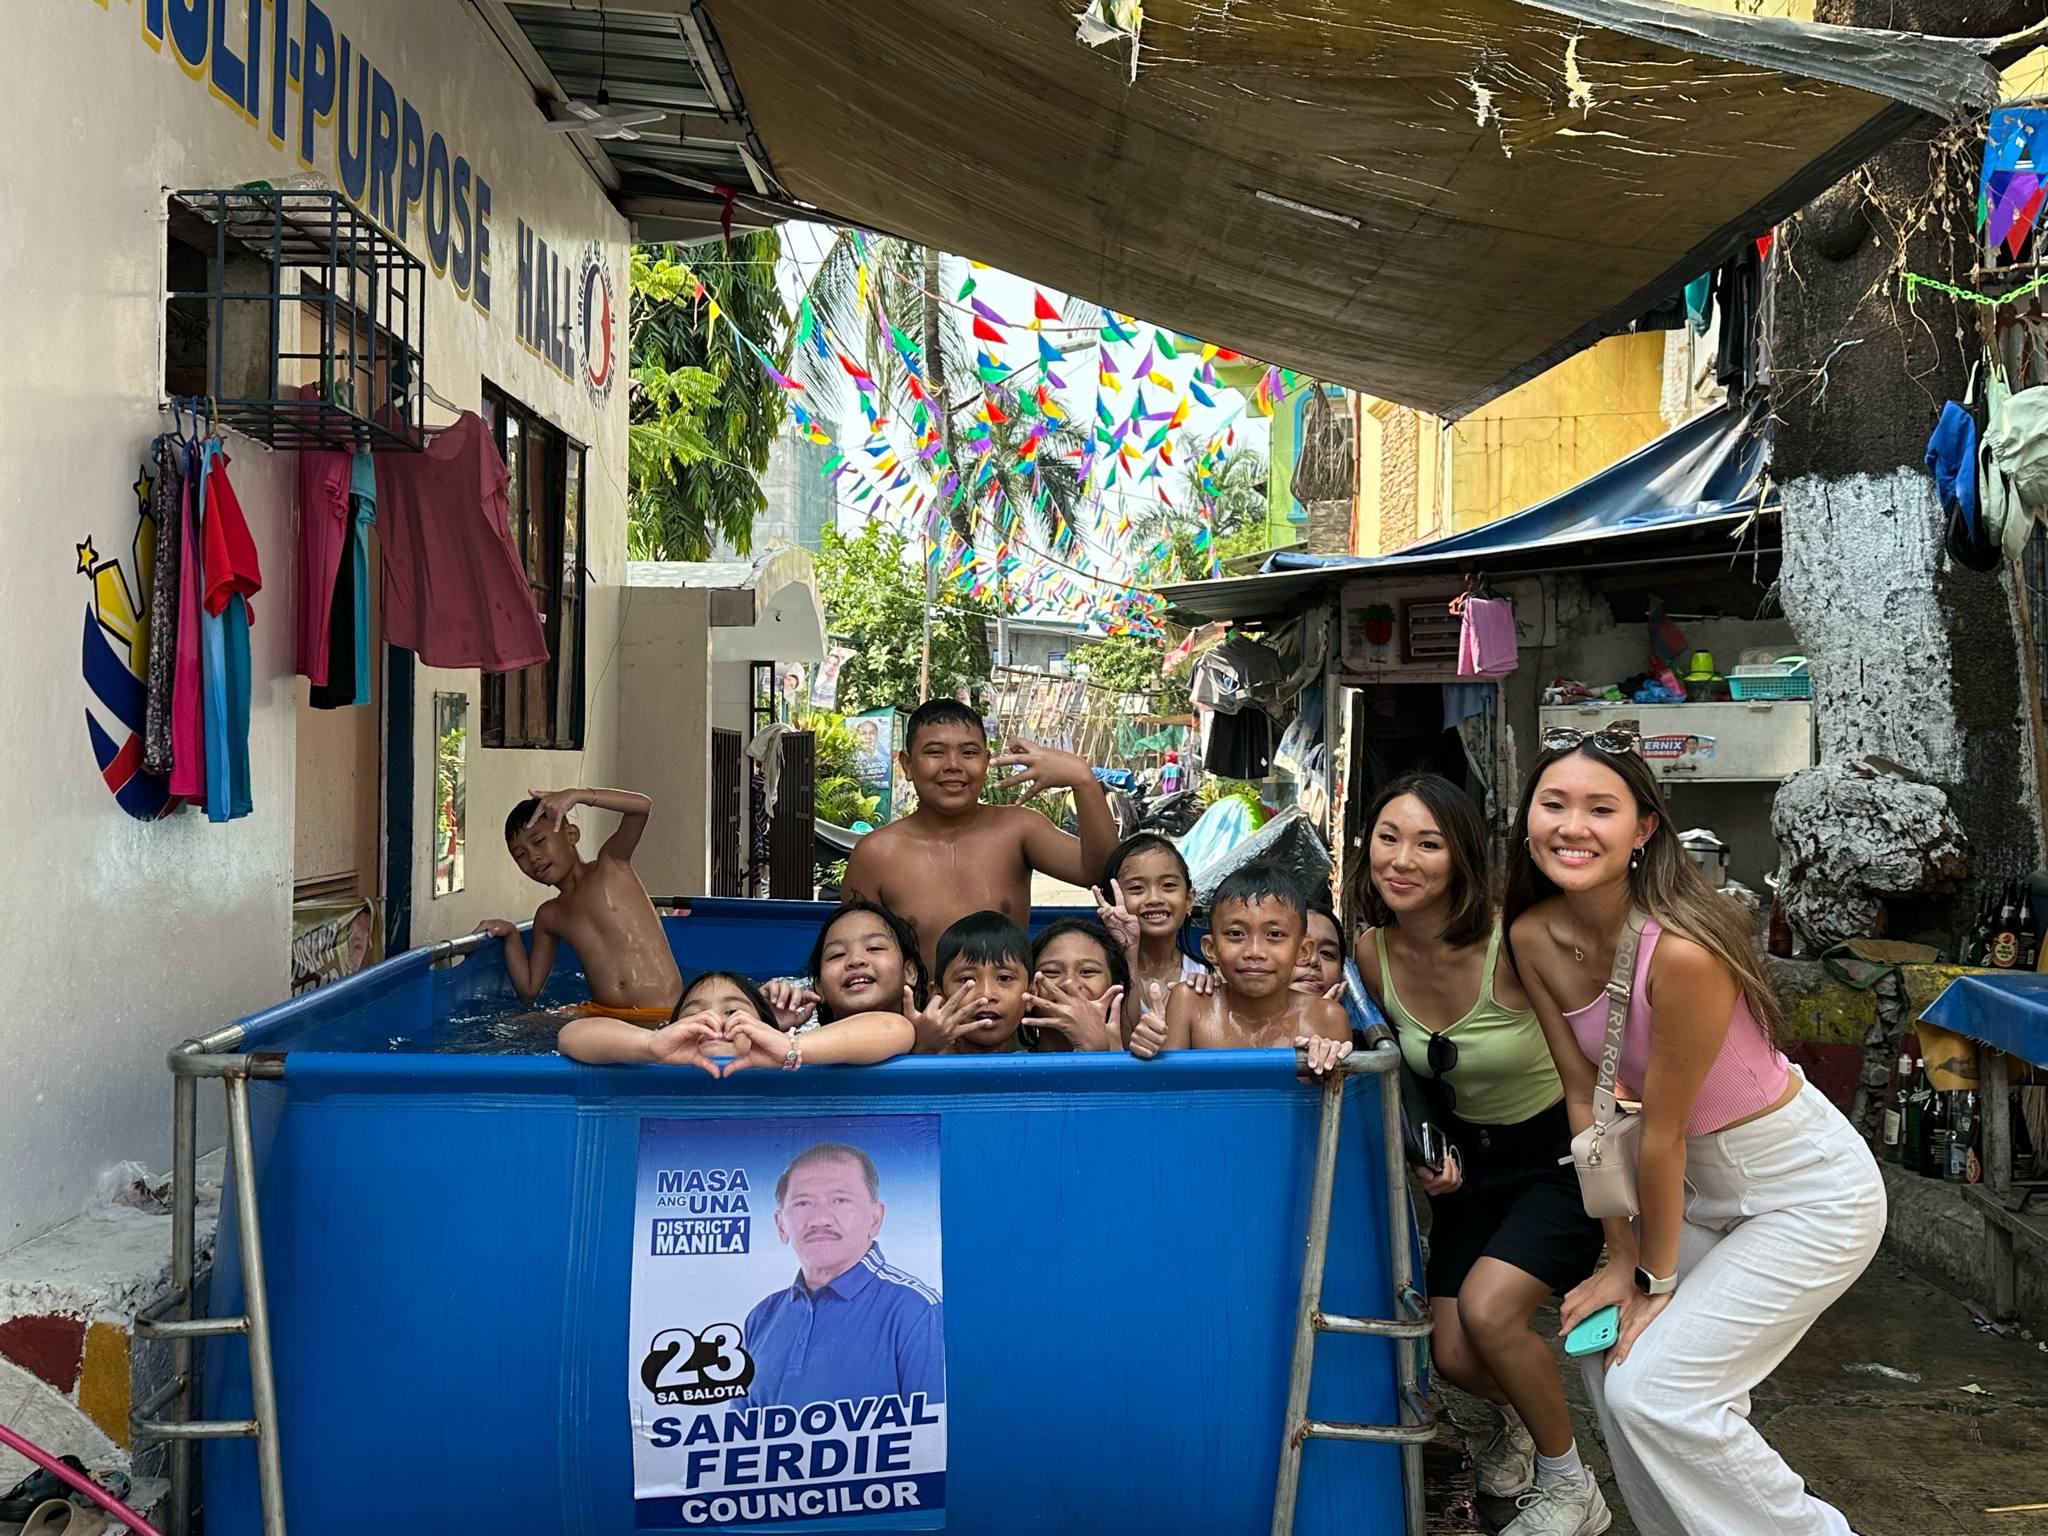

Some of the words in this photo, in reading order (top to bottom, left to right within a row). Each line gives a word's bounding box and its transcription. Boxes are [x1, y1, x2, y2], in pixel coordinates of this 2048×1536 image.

[516, 217, 575, 384] HALL
[1644, 741, 1682, 750] ERNIX
[657, 1169, 750, 1193] MASA
[656, 1196, 687, 1207] ANG
[689, 1194, 750, 1214] UNA
[657, 1220, 733, 1235] DISTRICT
[737, 1219, 745, 1234] 1
[655, 1233, 745, 1254] MANILA
[651, 1323, 746, 1389] 23
[656, 1391, 679, 1403] SA
[682, 1385, 746, 1401] BALOTA
[650, 1393, 939, 1448] SANDOVAL
[685, 1431, 913, 1490] FERDIE
[681, 1481, 921, 1525] COUNCILOR
